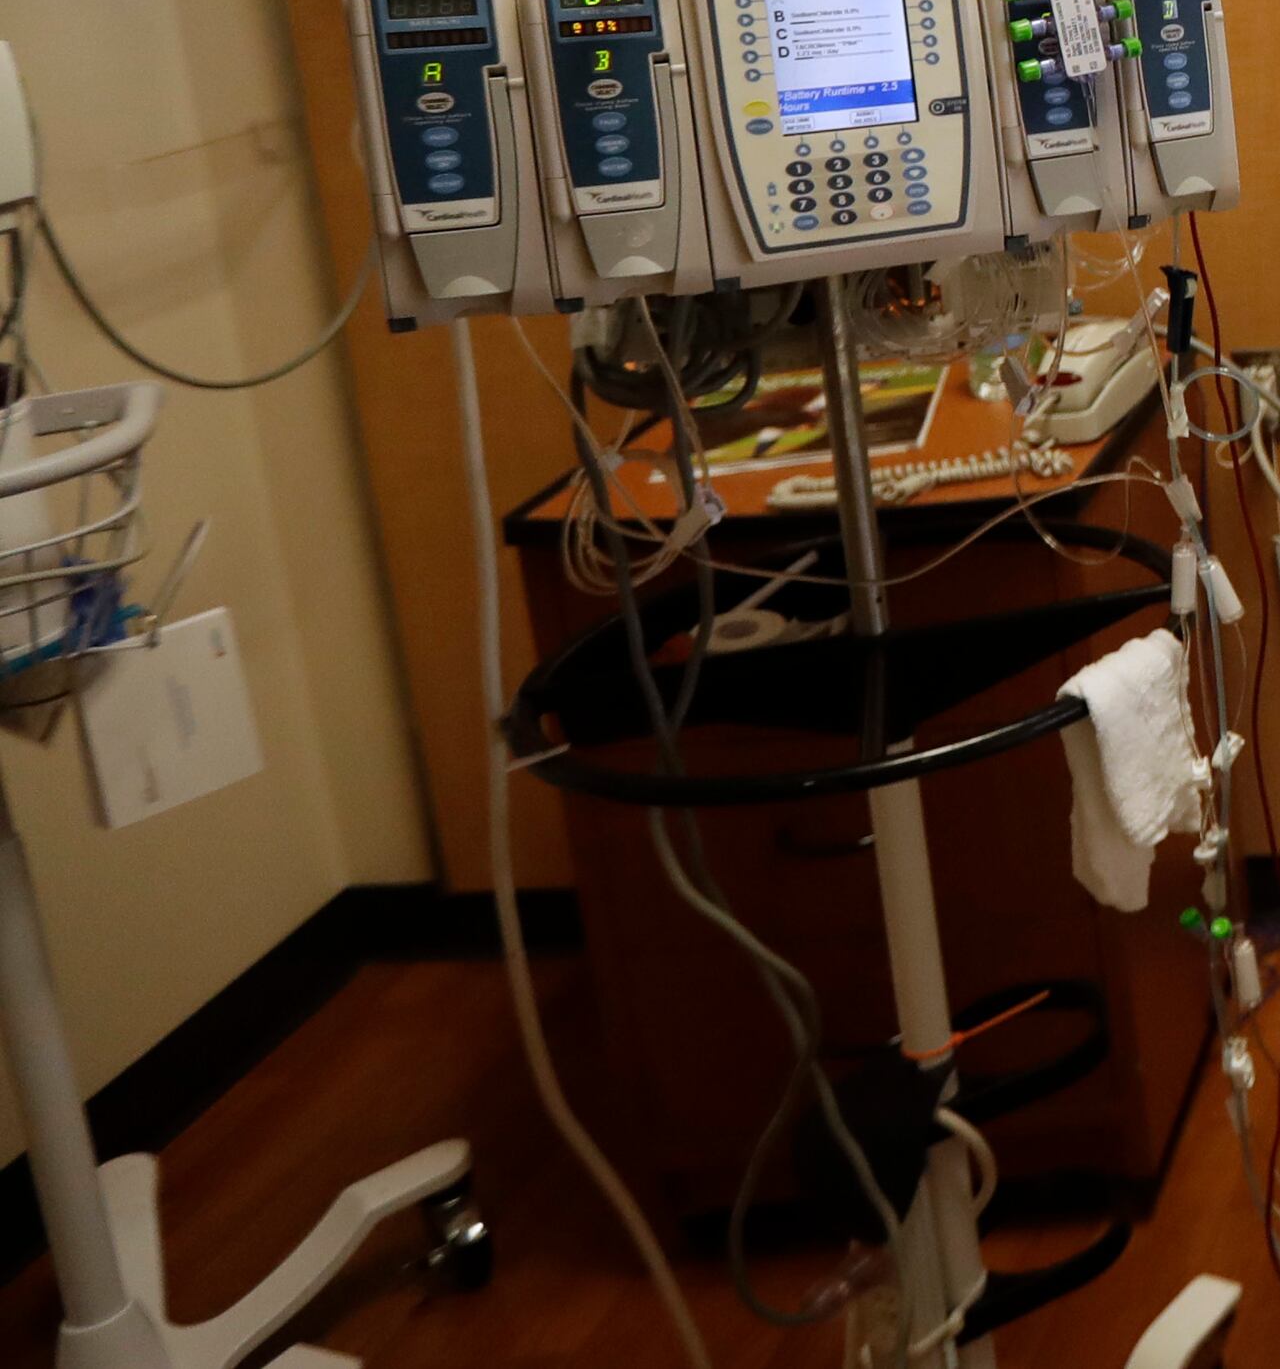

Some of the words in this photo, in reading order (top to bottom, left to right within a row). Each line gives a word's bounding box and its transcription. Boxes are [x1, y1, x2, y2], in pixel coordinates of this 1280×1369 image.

[774, 10, 785, 23] B
[776, 29, 788, 40] C
[778, 46, 790, 58] D
[423, 61, 442, 82] A
[783, 89, 821, 101] Battery
[823, 85, 866, 97] Runtime
[881, 82, 898, 92] 2.5
